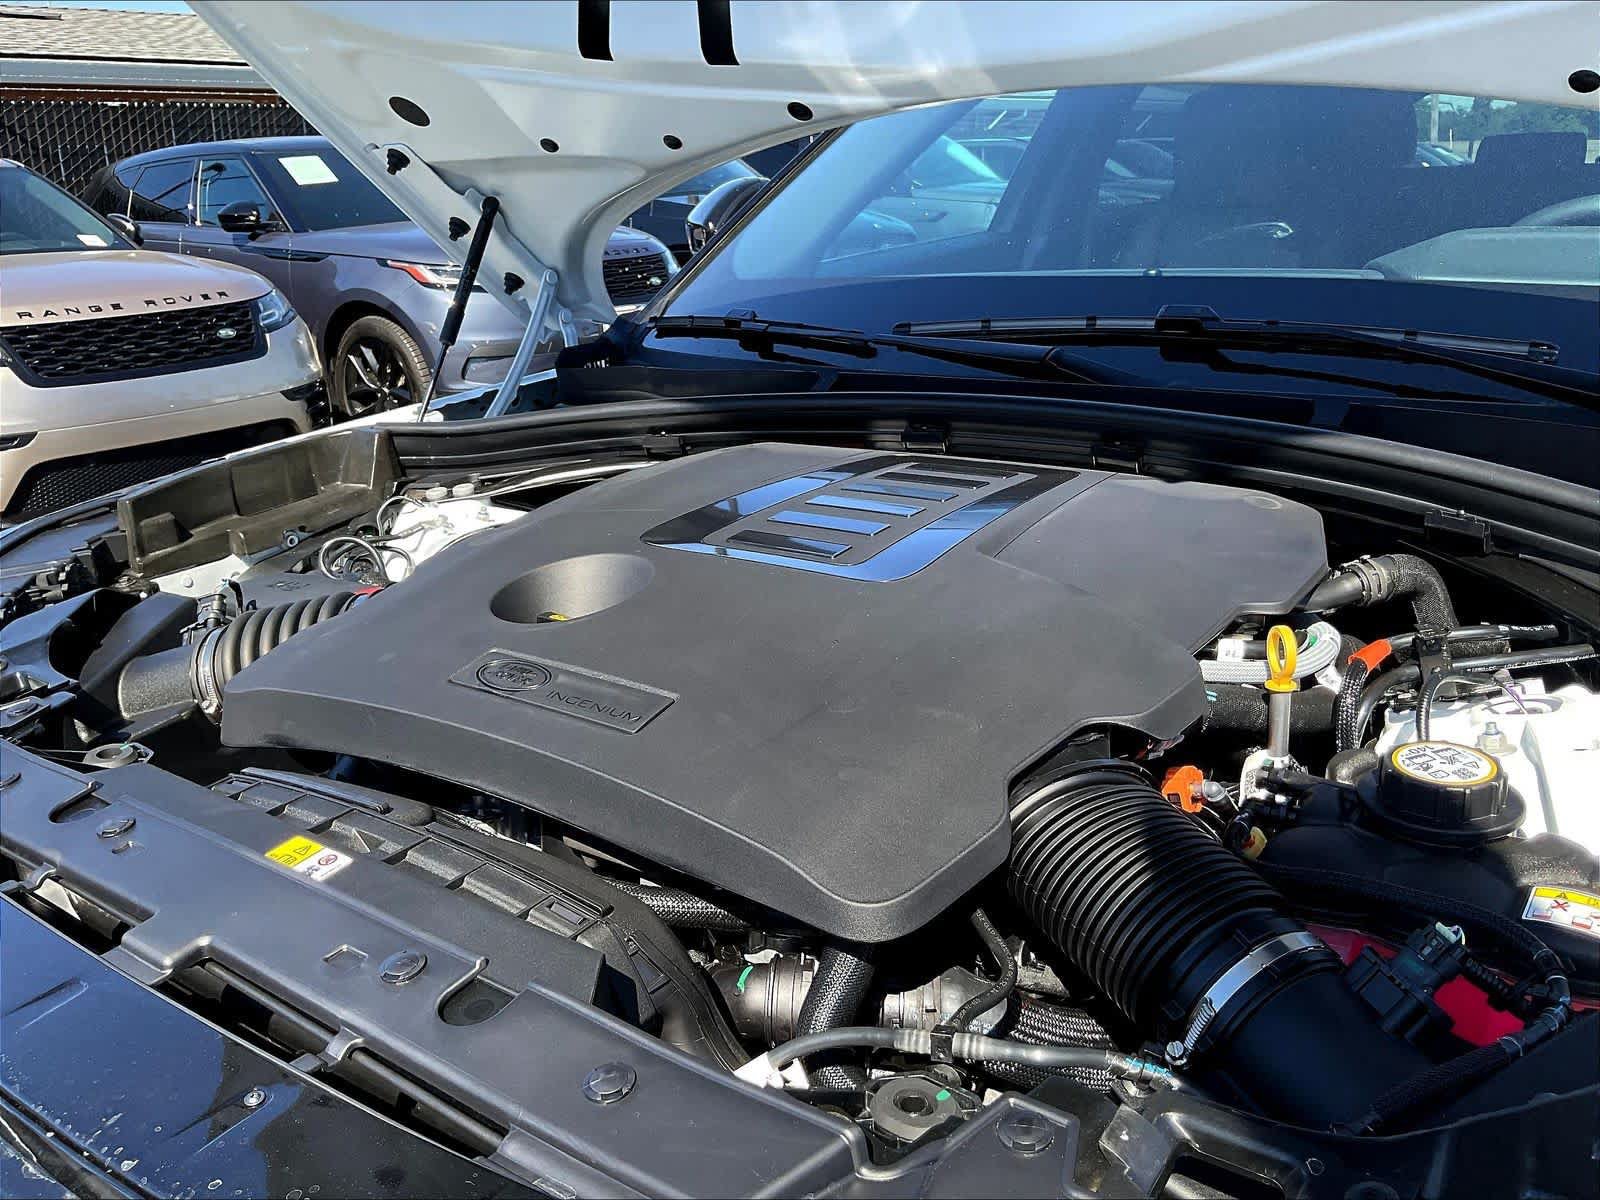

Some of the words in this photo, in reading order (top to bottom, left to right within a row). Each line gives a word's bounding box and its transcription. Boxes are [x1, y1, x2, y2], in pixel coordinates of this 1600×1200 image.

[15, 303, 124, 319] RANGE
[143, 290, 230, 307] ROVER
[546, 688, 642, 722] INGENIUM
